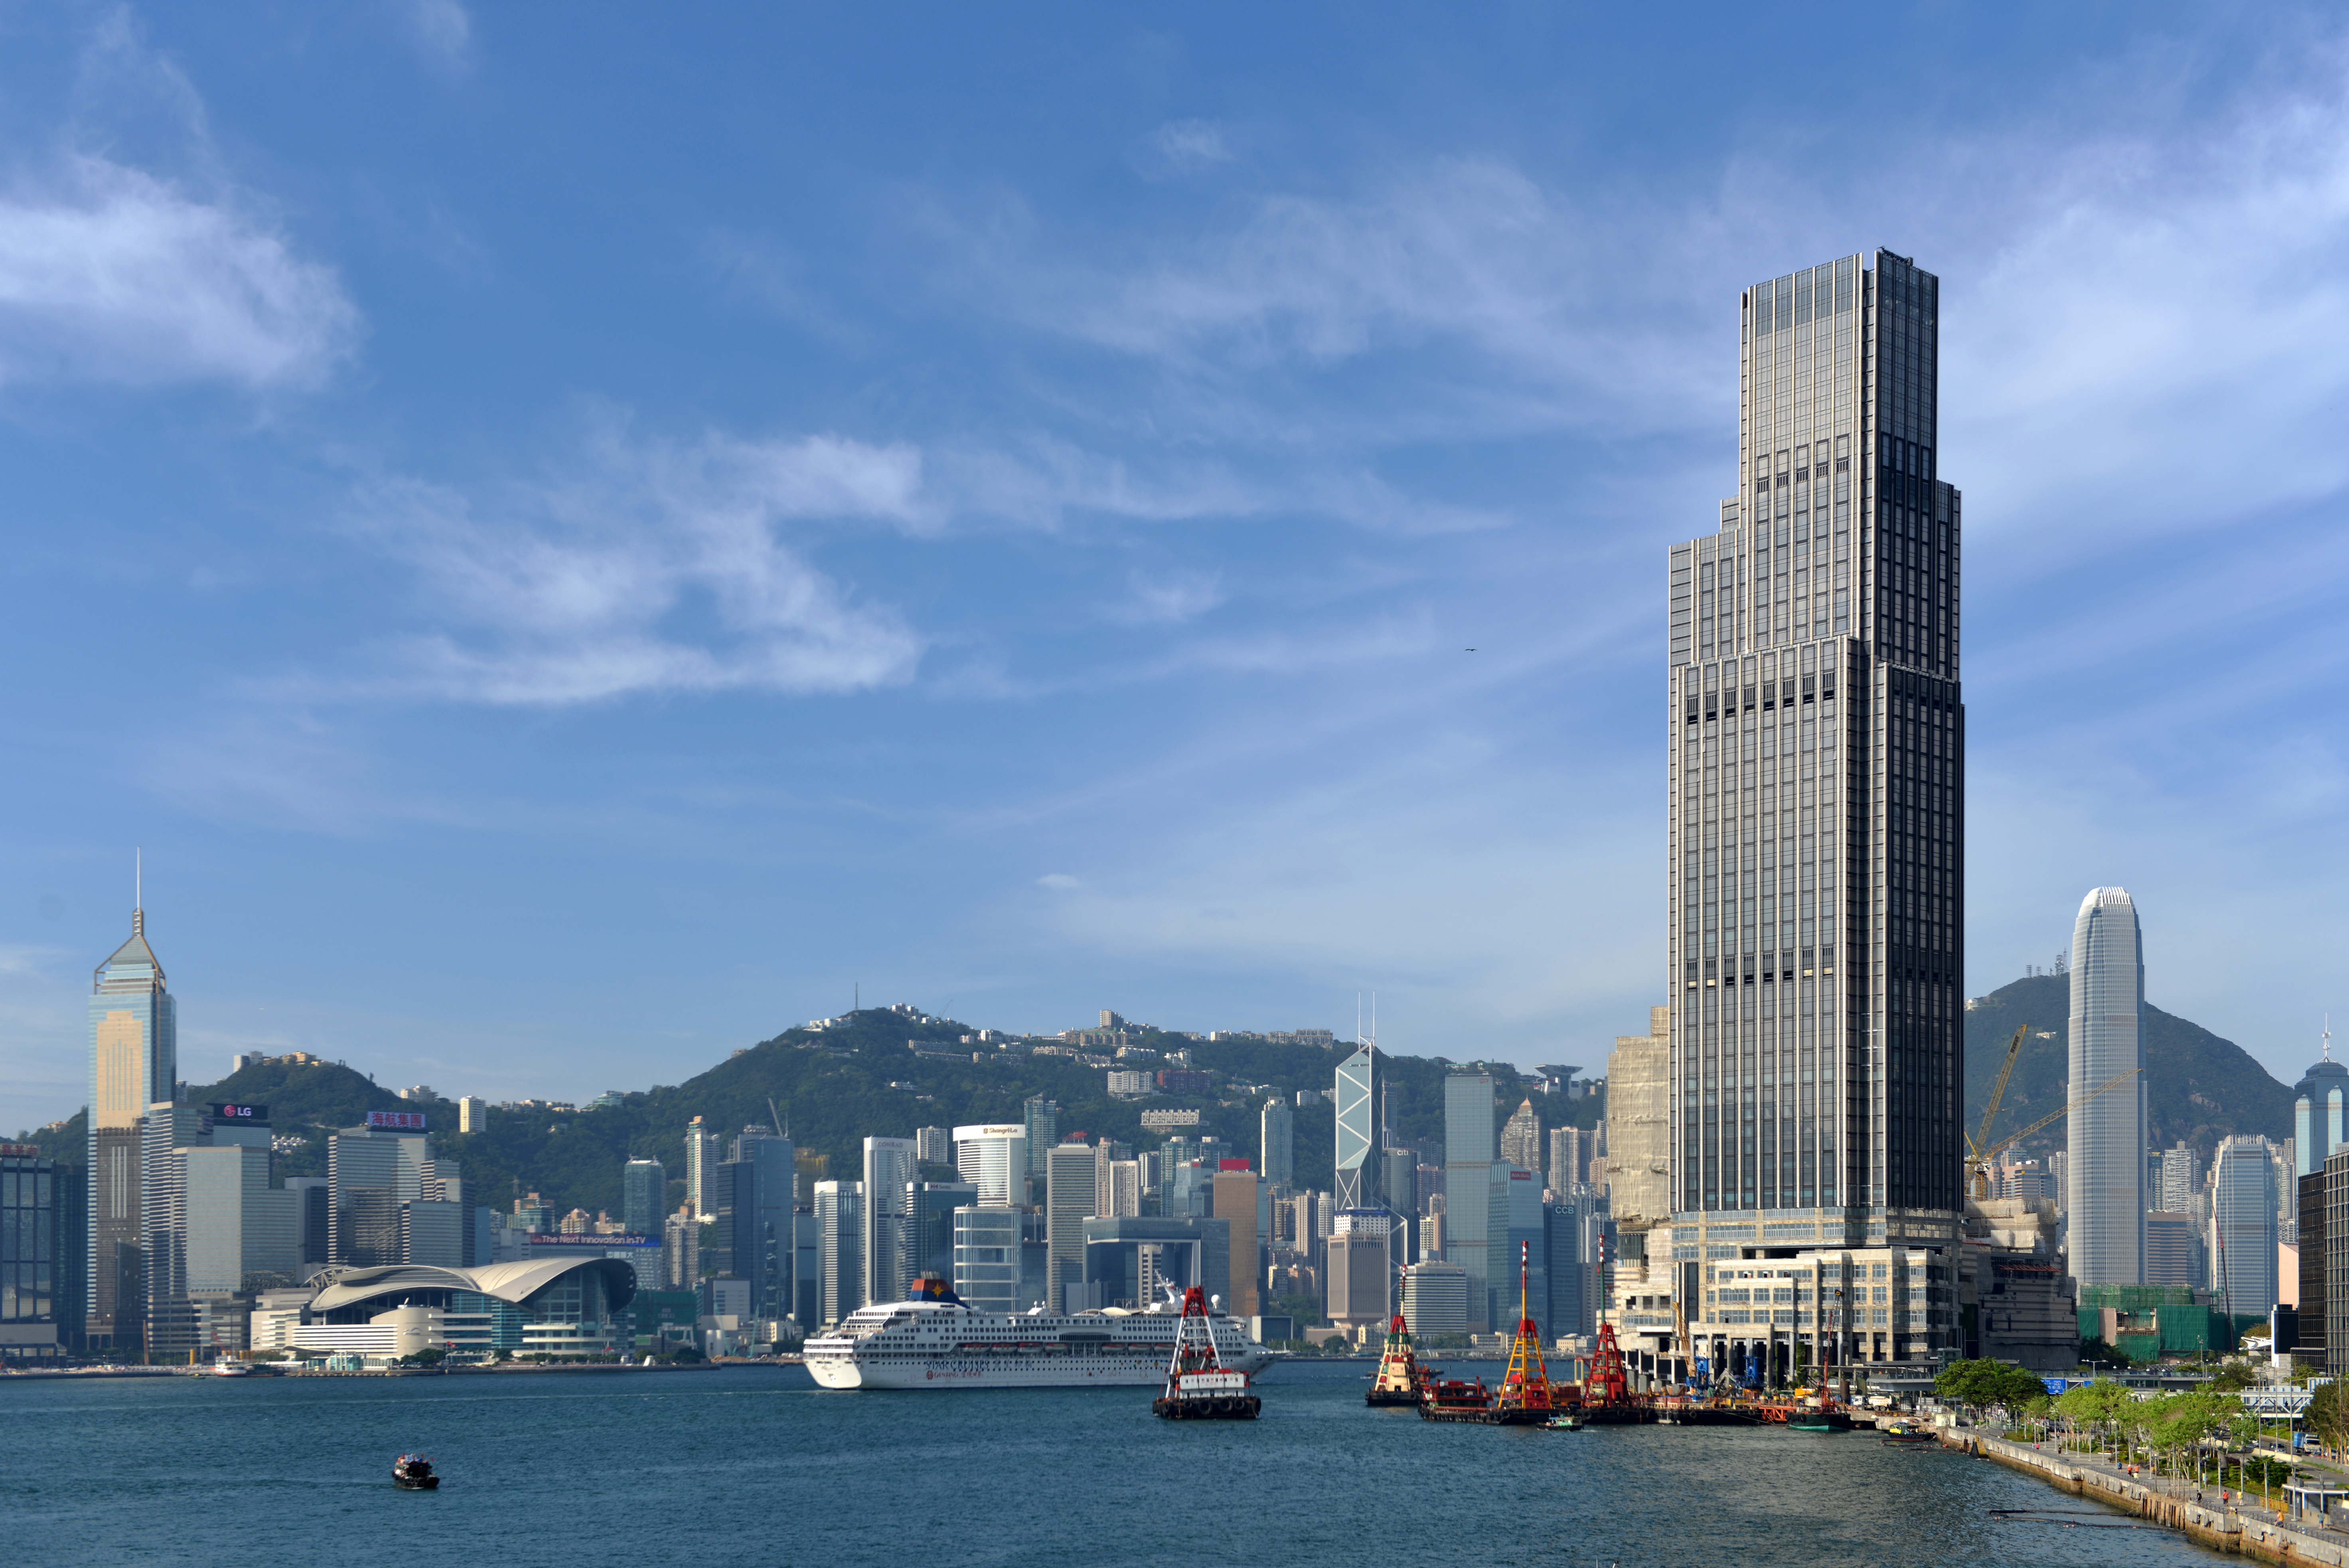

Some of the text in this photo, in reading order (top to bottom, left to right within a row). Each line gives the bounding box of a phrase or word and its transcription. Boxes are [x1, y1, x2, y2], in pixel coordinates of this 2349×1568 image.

[237, 1107, 251, 1116] LG
[372, 1112, 421, 1127] 海航集團
[926, 1360, 989, 1371] STAR CRUISES
